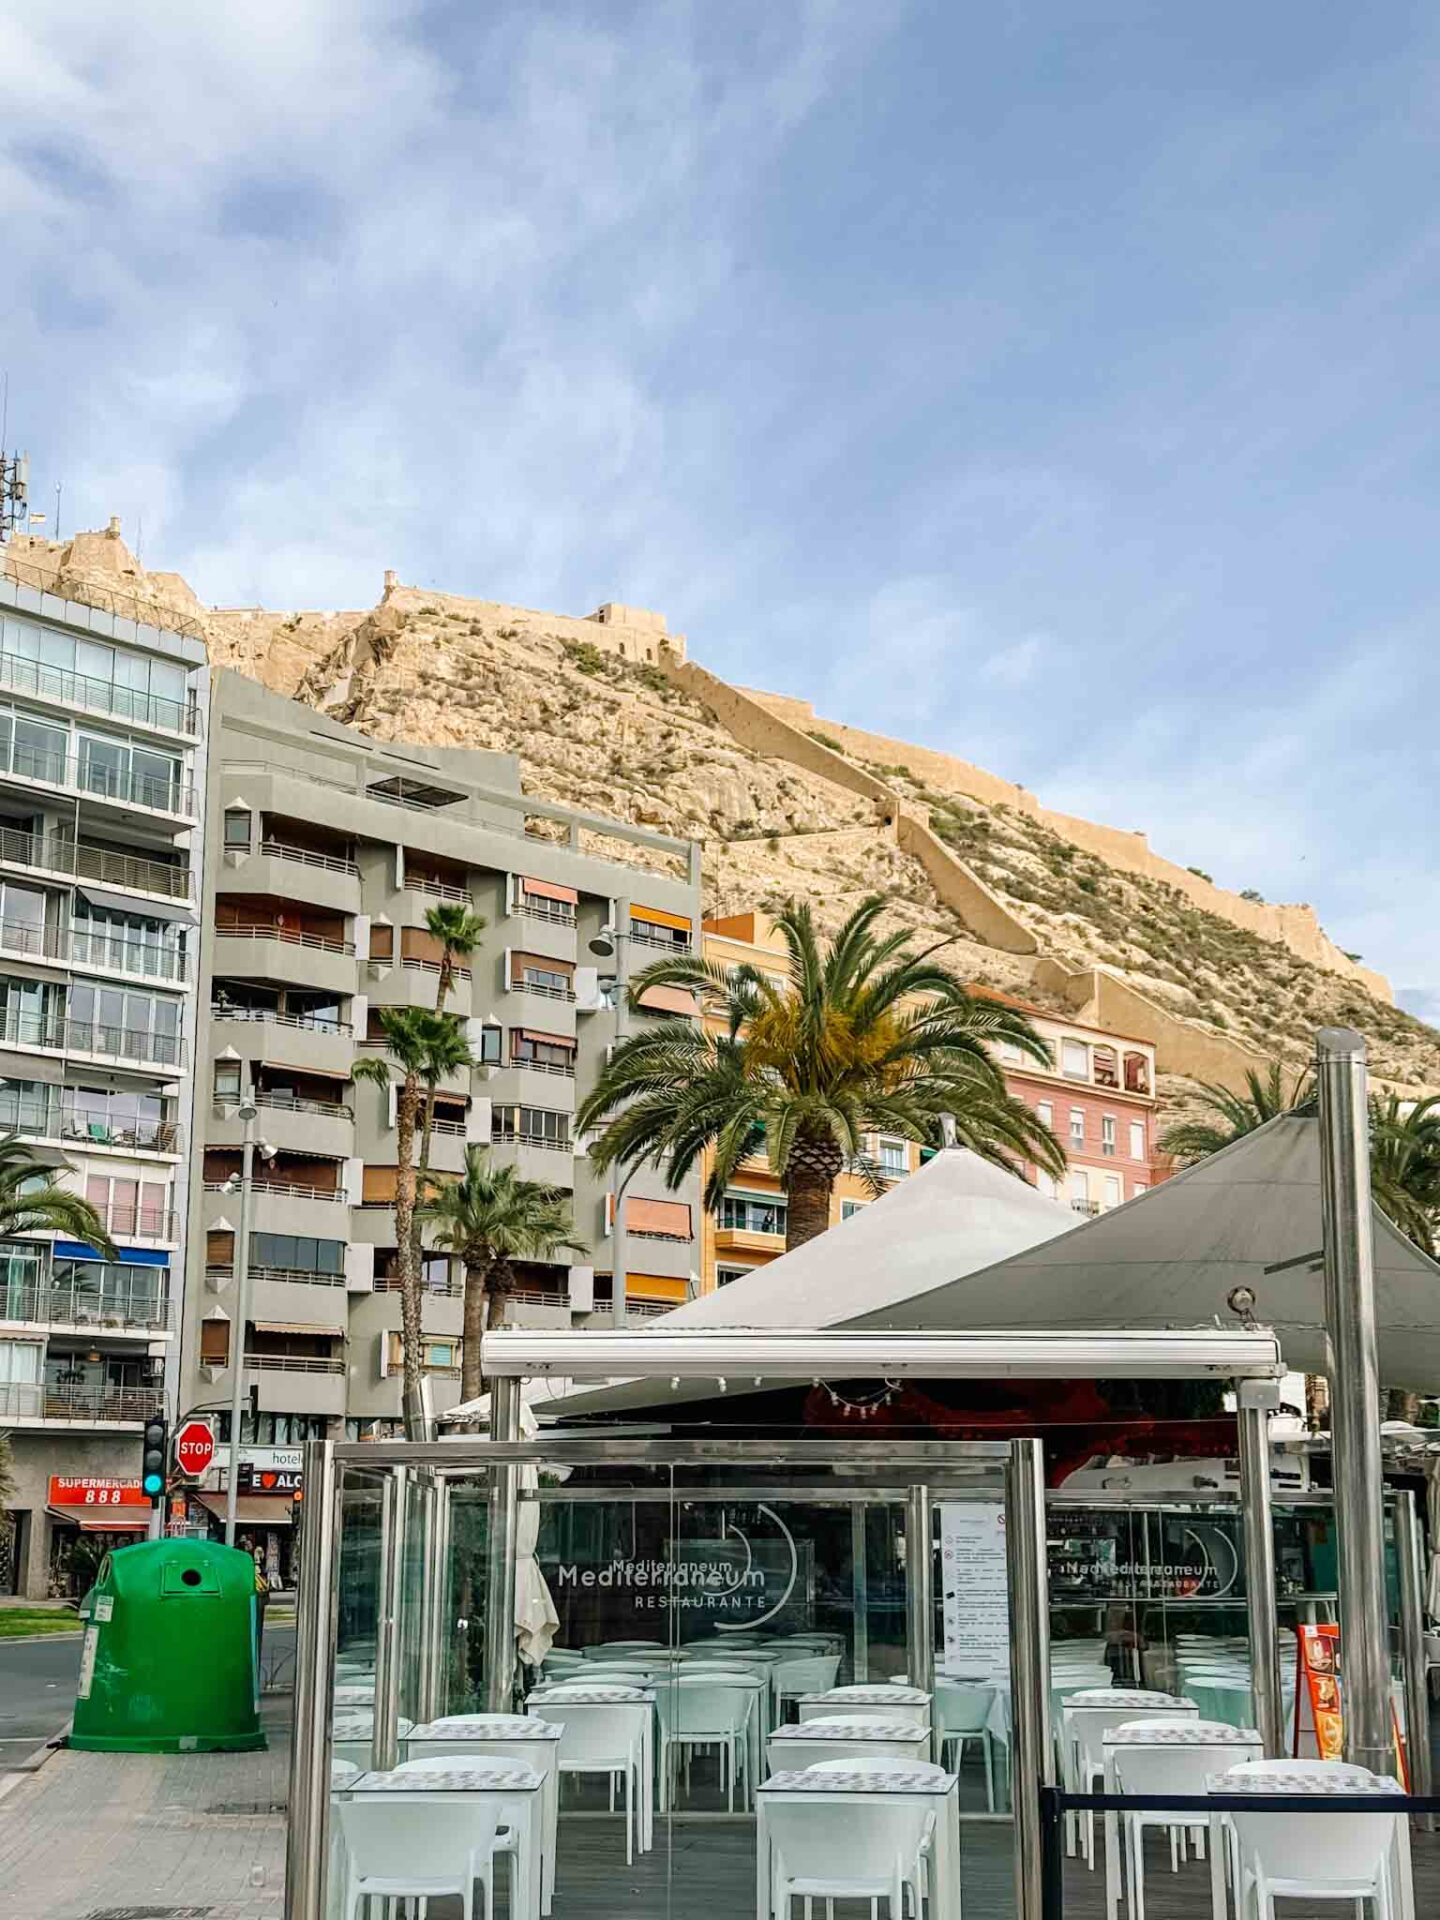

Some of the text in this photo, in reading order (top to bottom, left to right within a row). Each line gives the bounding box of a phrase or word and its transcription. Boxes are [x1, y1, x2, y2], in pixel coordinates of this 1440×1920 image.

[181, 1442, 211, 1455] STOP
[58, 1478, 142, 1489] SUPERMERCAD
[558, 1564, 765, 1587] Mediterraneum
[635, 1596, 765, 1608] RESTAURANTE
